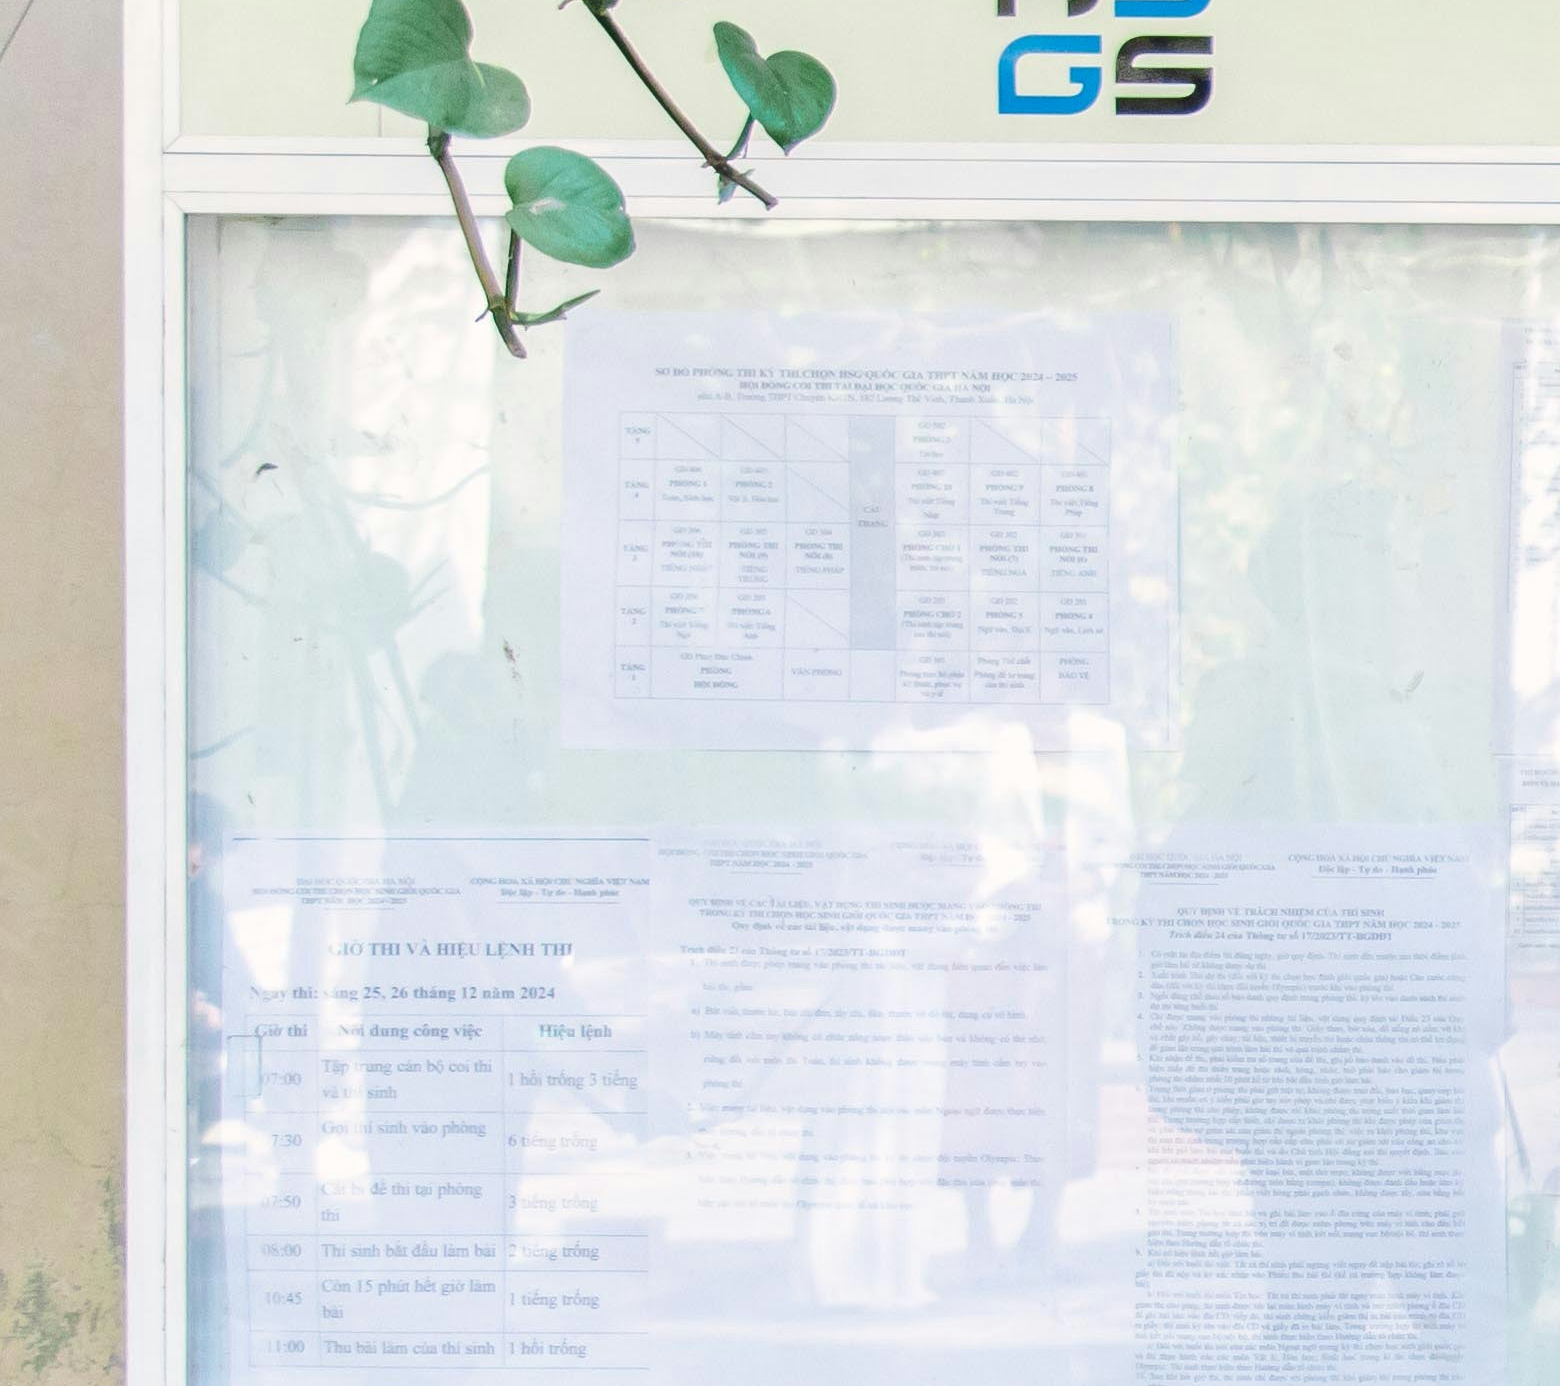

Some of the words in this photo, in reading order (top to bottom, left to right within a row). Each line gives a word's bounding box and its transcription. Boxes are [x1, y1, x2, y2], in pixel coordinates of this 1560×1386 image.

[997, 34, 1213, 116] GS
[369, 941, 401, 957] THI
[406, 938, 431, 957] VÀ
[436, 941, 481, 961] HIỆU
[485, 940, 536, 961] LỆNH
[540, 942, 574, 957] THI
[292, 986, 320, 1000] thi:
[323, 986, 359, 1002] áng
[391, 986, 408, 1000] 26
[412, 986, 457, 1003] tháng
[460, 986, 478, 1000] 12
[481, 987, 516, 1000] năm
[519, 986, 556, 1000] 2024
[288, 1023, 309, 1037] thi
[369, 1023, 409, 1041] dung
[412, 1022, 450, 1041] công
[453, 1023, 484, 1041] việc
[540, 1023, 576, 1041] Hiệu
[580, 1023, 614, 1041] lệnh
[426, 1059, 445, 1075] bộ
[448, 1059, 470, 1073] coi
[547, 1069, 585, 1090] trống
[602, 1069, 640, 1090] tiếng
[367, 1086, 398, 1100] sinh
[378, 1119, 408, 1134] sinh
[412, 1120, 439, 1134] vào
[442, 1119, 488, 1139] phòng
[268, 1133, 304, 1148] 7:30
[508, 1134, 517, 1148] 6
[520, 1130, 559, 1152] tiếng
[561, 1129, 601, 1152] trống
[415, 1181, 434, 1198] tại
[437, 1180, 484, 1200] phòng
[507, 1193, 517, 1209] 3
[521, 1191, 559, 1213] tiếng
[561, 1191, 600, 1213] trống
[350, 1243, 381, 1258] sinh
[411, 1240, 438, 1258] đầu
[443, 1243, 470, 1258] làm
[474, 1242, 498, 1258] bài
[561, 1239, 602, 1262] trống
[357, 1280, 376, 1294] 15
[378, 1278, 412, 1298] phút
[414, 1276, 439, 1294] hết
[441, 1278, 466, 1297] giờ
[469, 1279, 498, 1294] làm
[264, 1291, 305, 1306] 10:45
[521, 1288, 559, 1310] tiếng
[561, 1287, 602, 1310] trống
[267, 1340, 306, 1355] 11:00
[322, 1340, 353, 1355] Thu
[356, 1340, 378, 1355] bài
[381, 1340, 409, 1355] làm
[465, 1340, 497, 1356] sinh
[520, 1337, 546, 1356] hồi
[548, 1337, 590, 1359] trống
